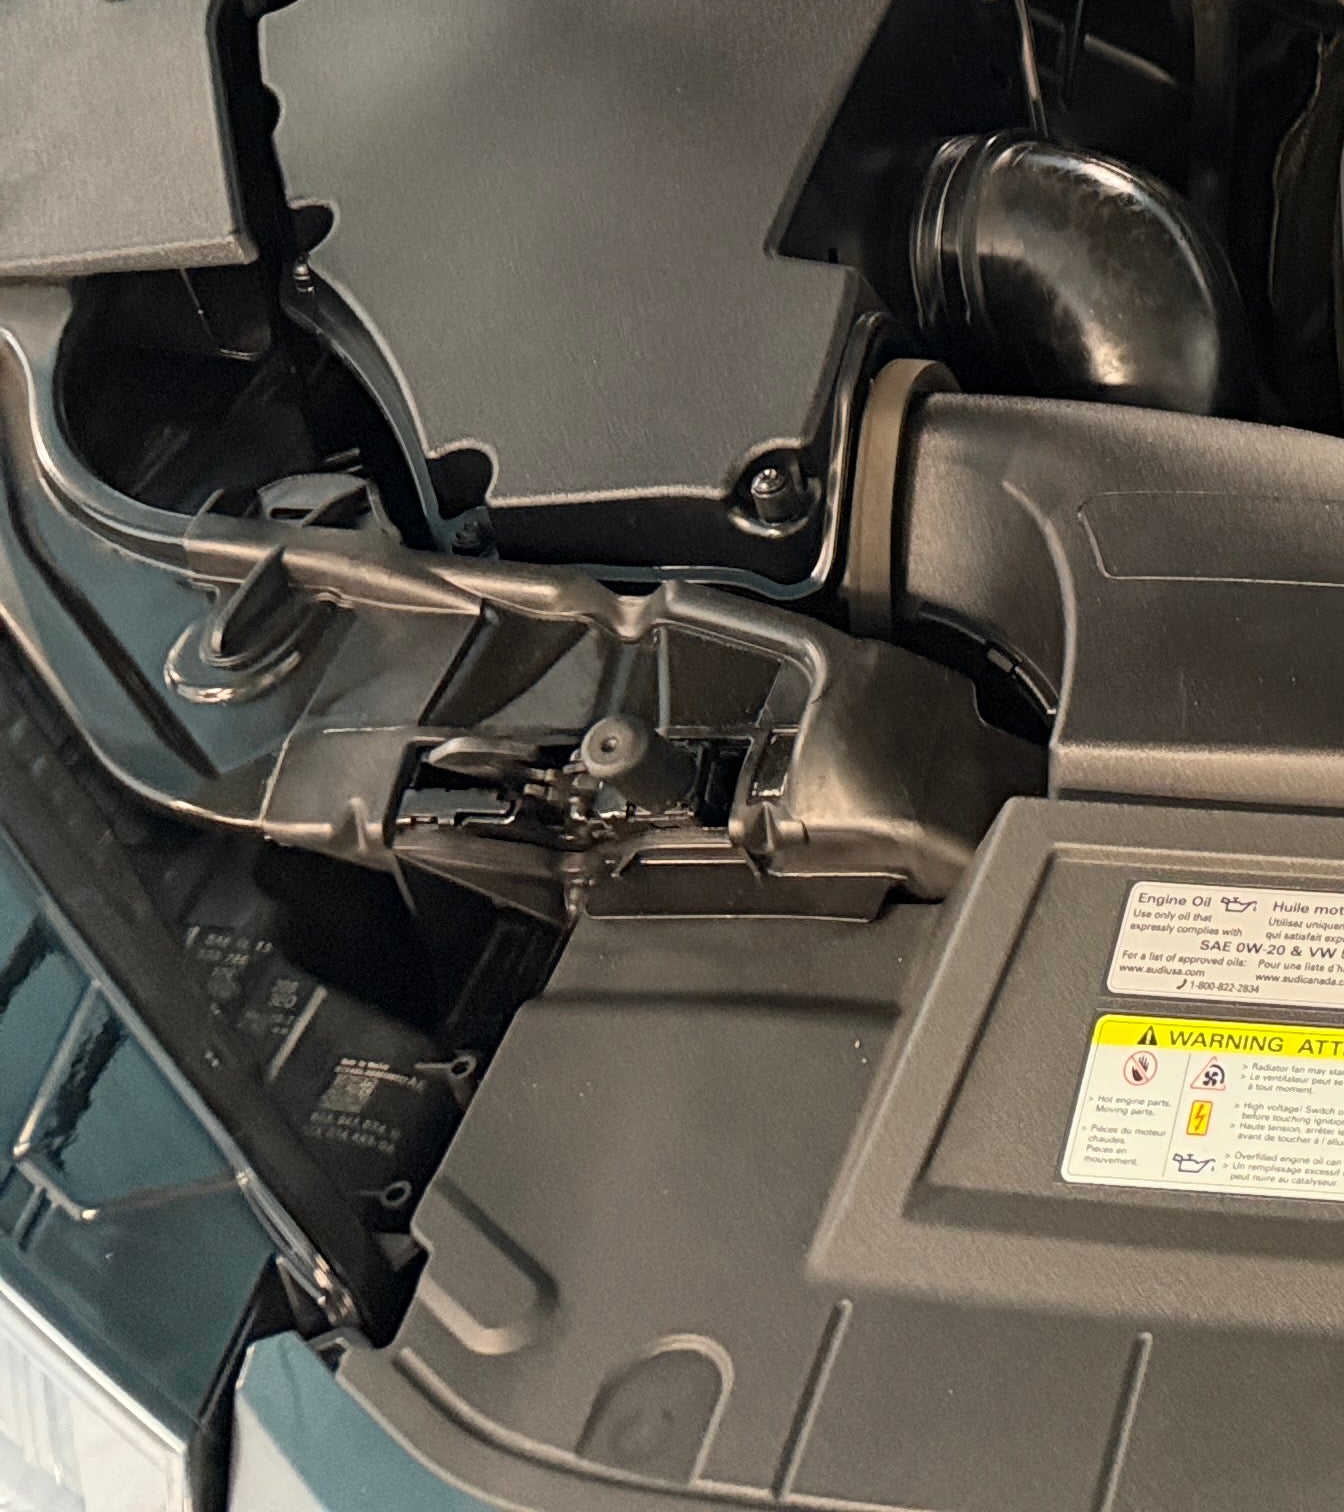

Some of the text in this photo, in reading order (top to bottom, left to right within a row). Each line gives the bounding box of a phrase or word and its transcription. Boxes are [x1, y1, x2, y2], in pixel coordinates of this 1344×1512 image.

[1138, 893, 1212, 907] Engine Oil
[1273, 901, 1310, 913] Huile
[1133, 909, 1212, 922] Use only oil that
[1130, 923, 1242, 937] expressly complies with
[1265, 931, 1281, 940] qui
[1284, 932, 1322, 941] satisfait
[1200, 940, 1232, 952] SAE
[1236, 942, 1286, 955] 0W-20
[1290, 946, 1302, 956] &
[1309, 947, 1337, 958] VW
[1122, 950, 1137, 960] For
[1149, 952, 1163, 961] list
[1166, 953, 1176, 962] of
[1178, 956, 1224, 966] approved
[1226, 958, 1247, 967] oils:
[1119, 965, 1205, 977] www.audiusa.com
[1259, 959, 1281, 969] Pour
[1283, 962, 1301, 970] une
[1305, 961, 1325, 972] liste
[1190, 981, 1259, 993] 1-800-822-2834
[1169, 1030, 1284, 1052] WARNING
[1252, 1062, 1289, 1072] Radiator
[1291, 1064, 1305, 1073] fan
[1308, 1067, 1327, 1076] may
[1250, 1073, 1261, 1081] Le
[1263, 1075, 1309, 1084] ventilateur
[1312, 1077, 1332, 1086] peut
[1256, 1084, 1273, 1092] tout
[1098, 1095, 1113, 1103] Hot
[1115, 1097, 1146, 1106] engine
[1096, 1105, 1128, 1116] Moving
[1243, 1102, 1264, 1113] High
[1267, 1104, 1302, 1114] voltage!
[1306, 1106, 1336, 1115] Switch
[1242, 1112, 1271, 1121] before
[1273, 1114, 1311, 1125] touching
[1240, 1122, 1266, 1131] Haute
[1237, 1133, 1262, 1141] avant
[1264, 1134, 1276, 1142] de
[1278, 1135, 1311, 1144] toucher
[1234, 1151, 1278, 1162] Overfilled
[1280, 1155, 1310, 1165] engine
[1313, 1156, 1324, 1165] oil
[1326, 1158, 1342, 1166] can
[1232, 1162, 1246, 1170] Un
[1248, 1164, 1302, 1175] remplissage
[1304, 1167, 1341, 1176] excessif
[1230, 1173, 1250, 1182] peut
[1253, 1174, 1275, 1183] nuire
